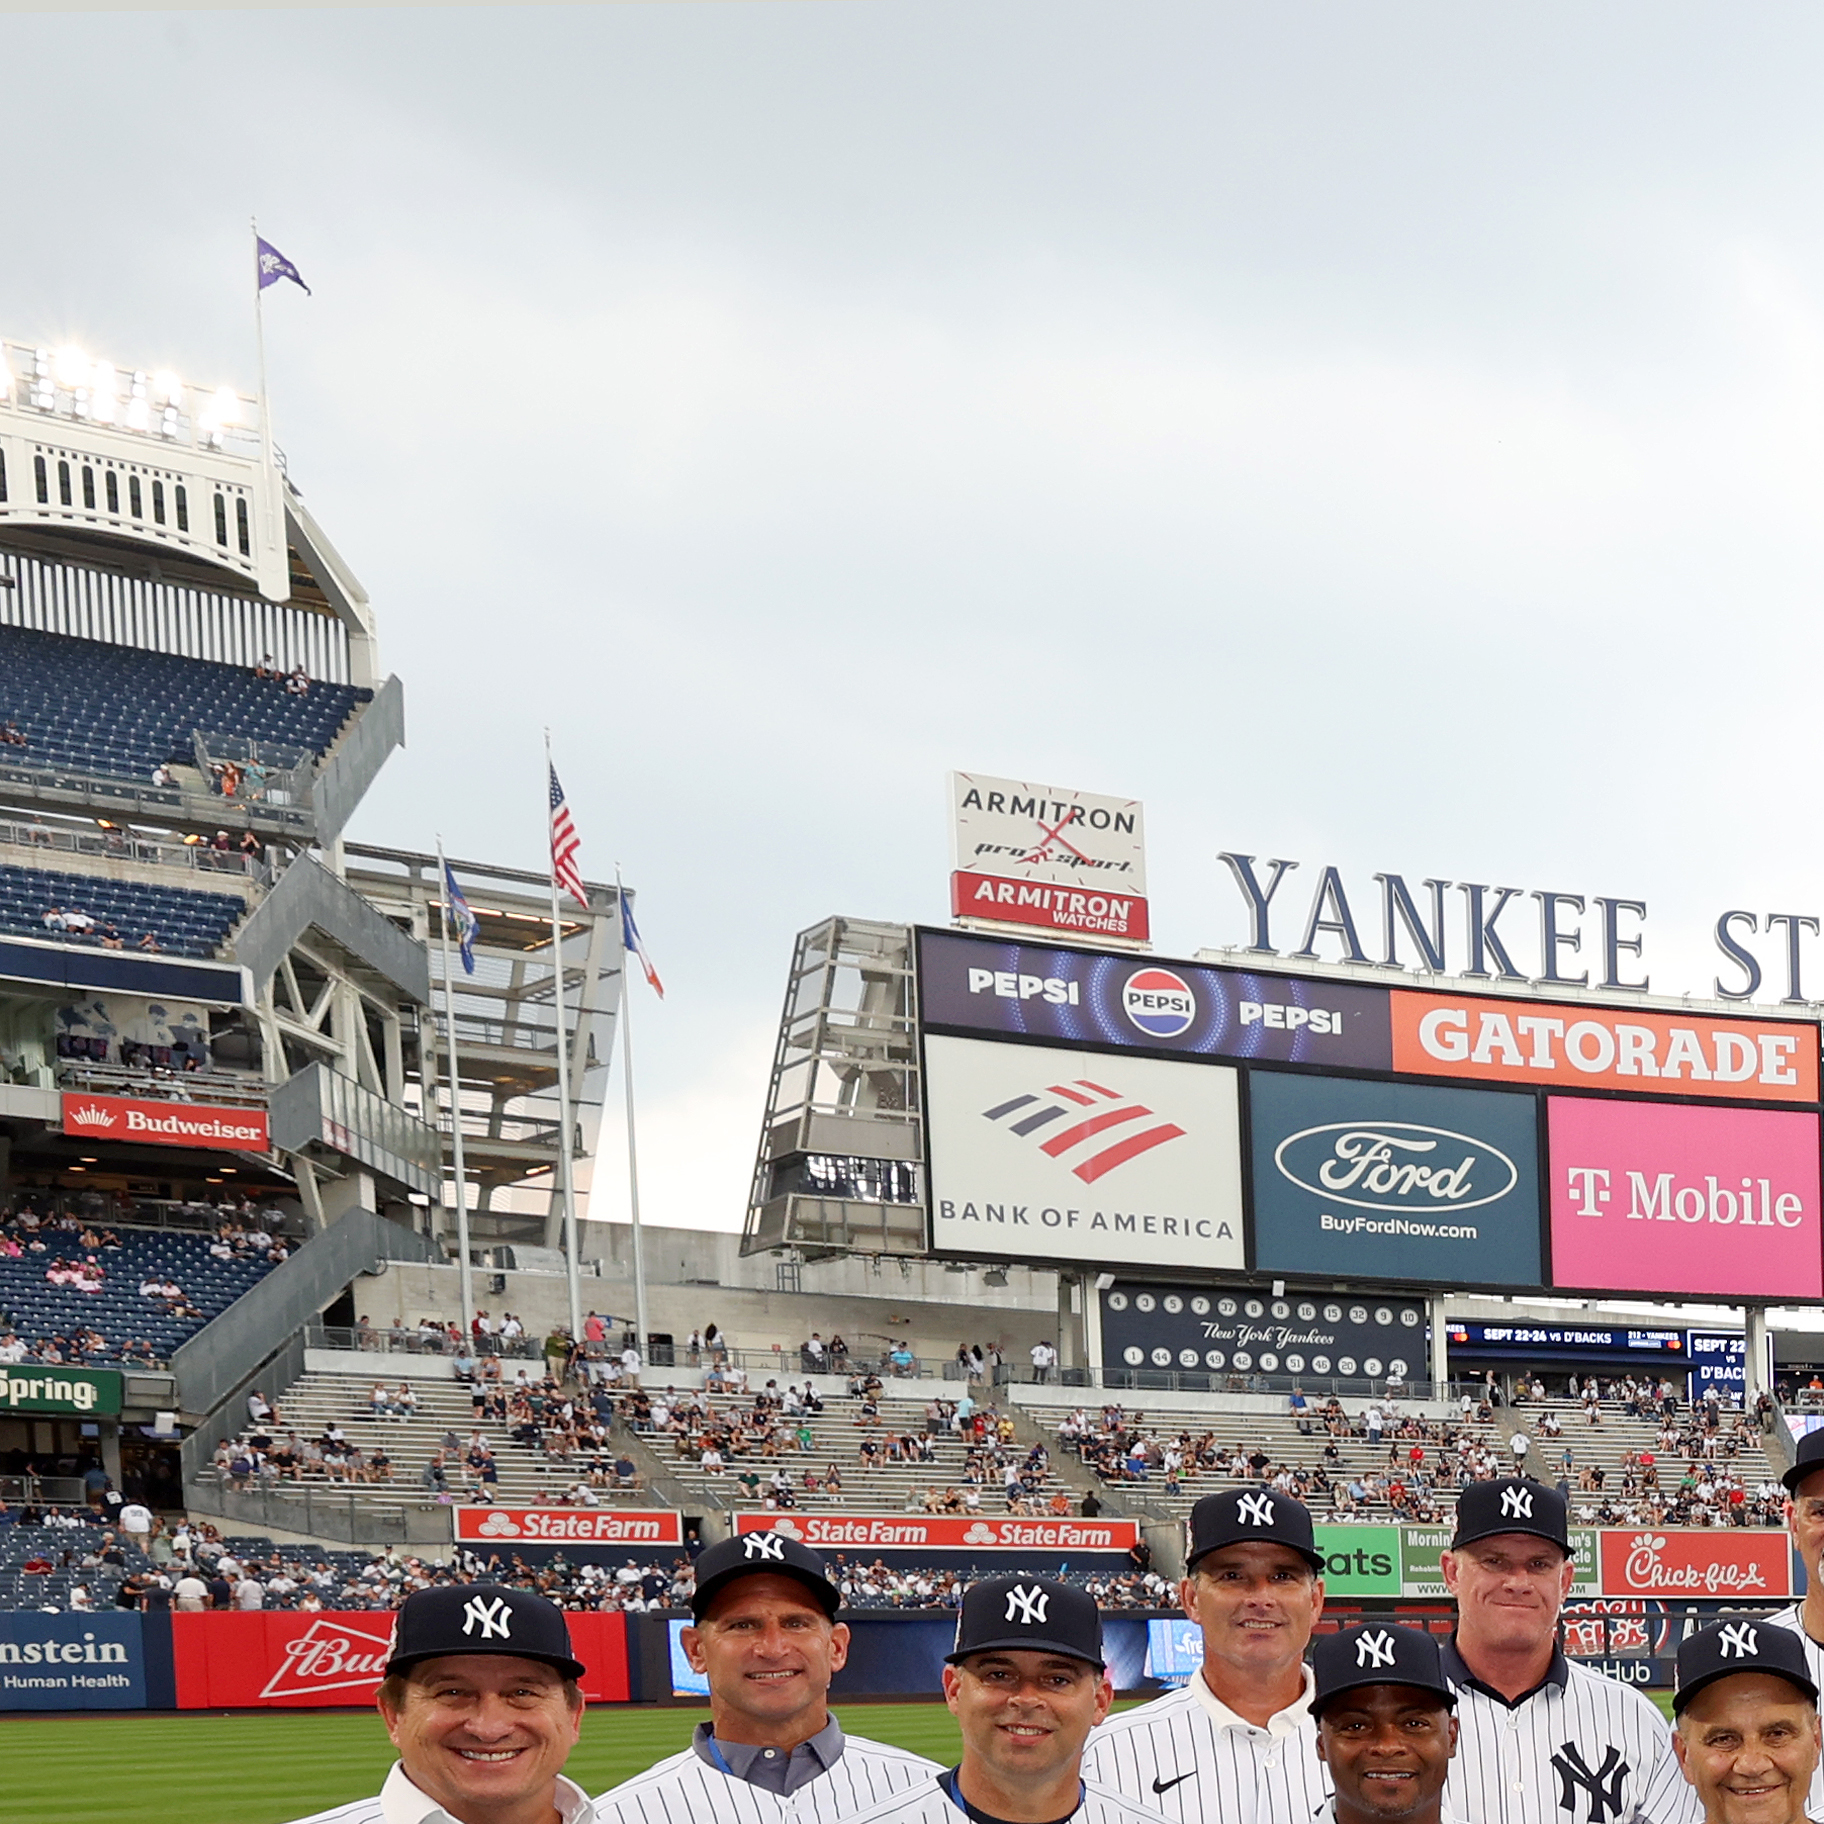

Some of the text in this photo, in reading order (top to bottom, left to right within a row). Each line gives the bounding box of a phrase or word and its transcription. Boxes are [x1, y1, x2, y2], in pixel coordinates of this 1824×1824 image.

[961, 788, 1135, 834] ARMITRON
[974, 881, 1128, 919] ARMITRON
[1052, 910, 1128, 932] WATCHES
[1217, 852, 1649, 990] YANKEE
[968, 968, 1342, 1035] PEPSI PEPSI PEPSI
[1419, 1009, 1798, 1085] GATORADE
[125, 1109, 262, 1141] Budweiser
[1319, 1131, 1475, 1200] Ford
[1627, 1170, 1803, 1228] Mobile
[940, 1199, 1234, 1240] BANK OF AMERICA
[1320, 1215, 1477, 1239] BuyFordNow.com
[1200, 1321, 1335, 1349] New York Yankees
[1484, 1328, 1612, 1344] SEPT D'BACKS
[1694, 1339, 1727, 1353] SEPT
[1237, 1492, 1275, 1526] NY
[1501, 1486, 1533, 1518] NY
[744, 1532, 785, 1561] NY
[1625, 1546, 1766, 1593] Chick-fil-A
[463, 1596, 512, 1638] NY
[1005, 1585, 1048, 1623] NY
[1356, 1630, 1395, 1667] NY
[1718, 1622, 1758, 1657] NY
[4, 1673, 130, 1690] Human Health
[1550, 1740, 1631, 1824] NY
